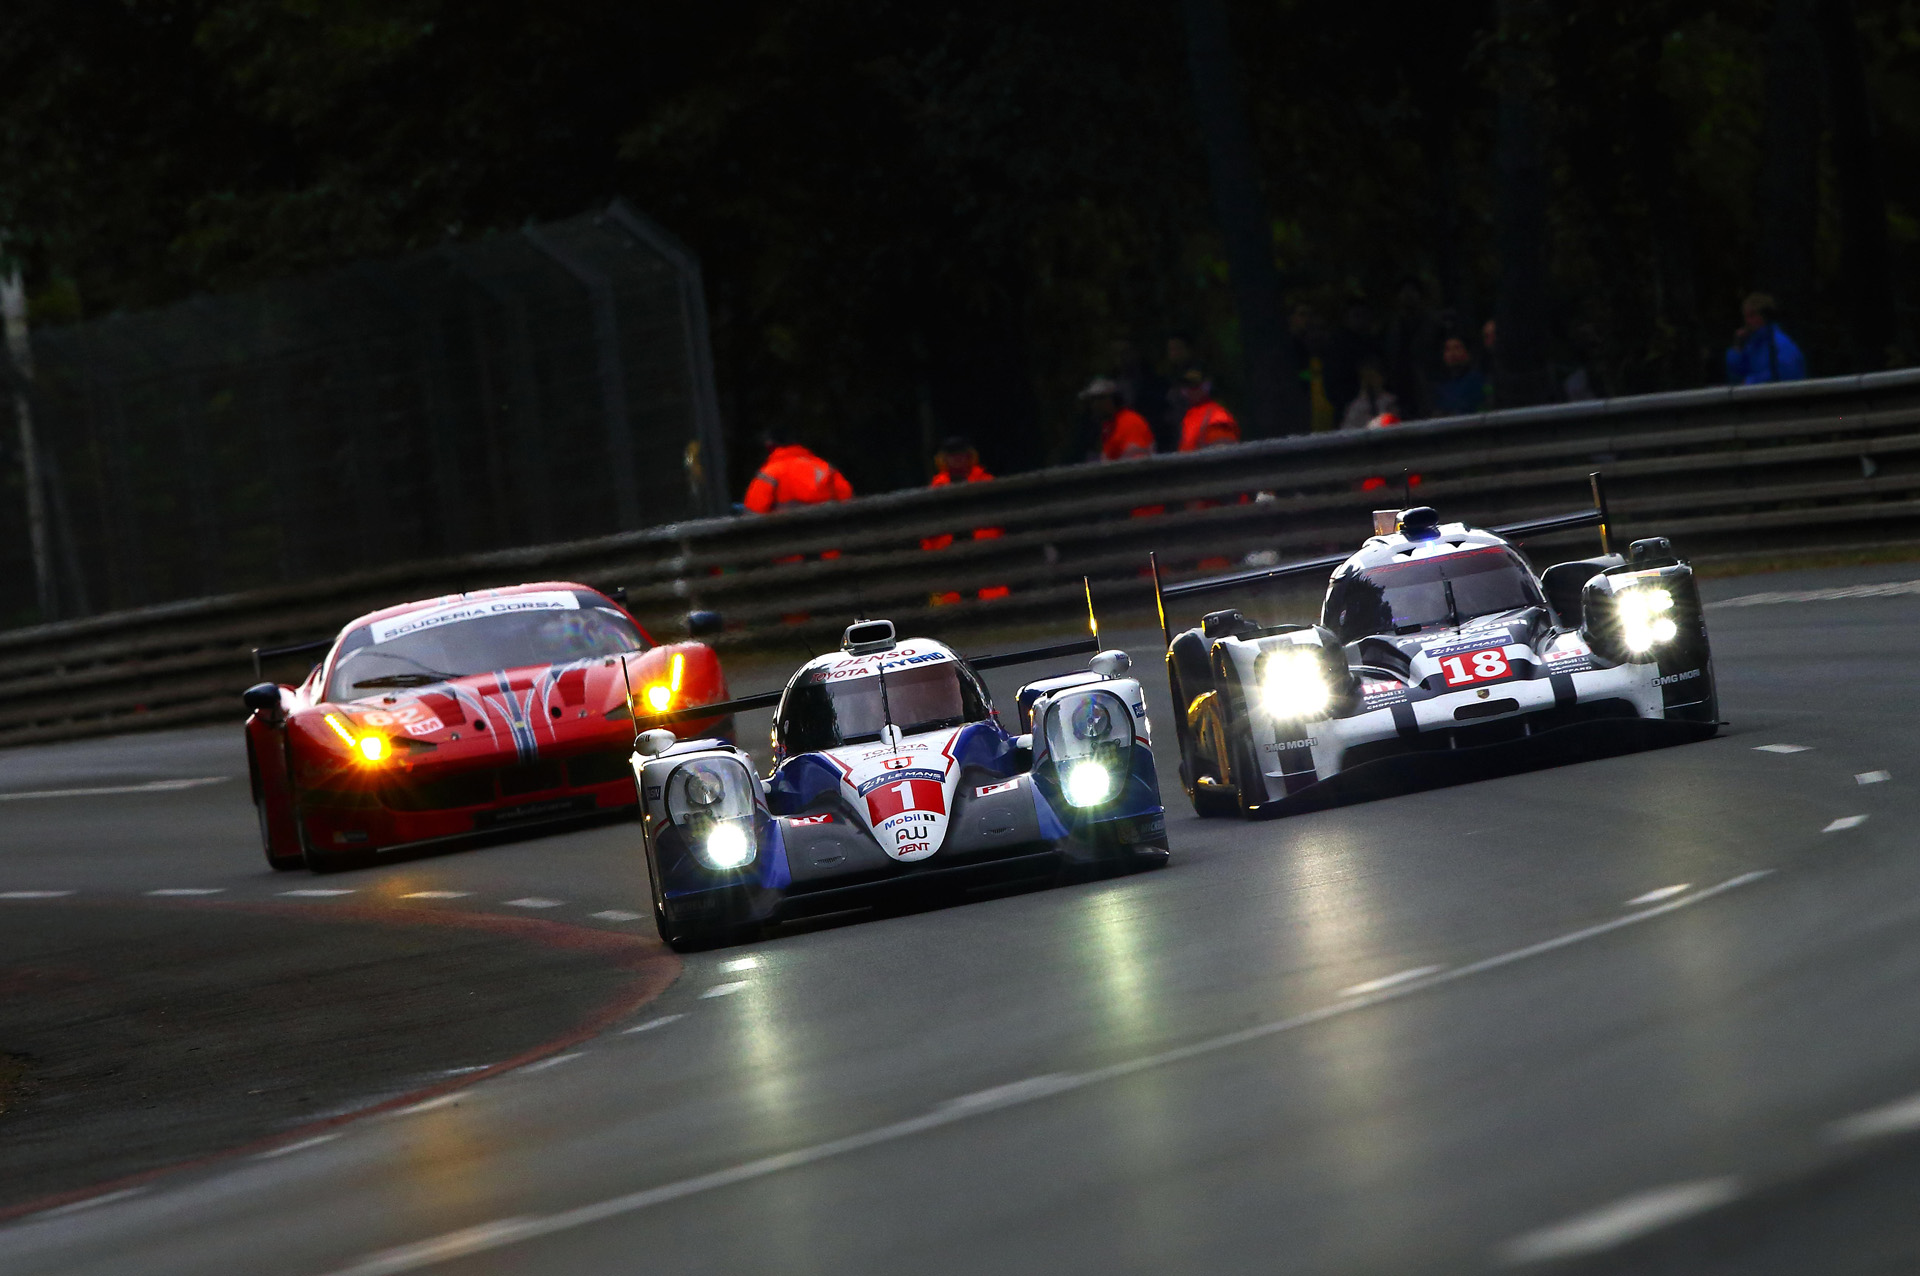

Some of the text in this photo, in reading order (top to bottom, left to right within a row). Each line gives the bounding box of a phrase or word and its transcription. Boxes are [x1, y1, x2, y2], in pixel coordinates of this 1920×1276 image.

[383, 601, 565, 638] SCUDERIA CORSA
[835, 649, 916, 668] DENSO
[1547, 658, 1578, 667] Mobil
[810, 652, 946, 683] TOYOTA HYBRID
[1442, 651, 1507, 684] 18
[1551, 666, 1592, 675] CHOPARD
[1652, 668, 1700, 687] DMG MORI
[1363, 681, 1398, 694] HY
[1363, 692, 1393, 701] Mobil
[1366, 699, 1408, 710] CHOPARD
[363, 708, 425, 726] 62
[411, 720, 439, 733] AM
[862, 744, 928, 762] TOYOTA
[1264, 737, 1318, 753] DMG MORI
[888, 772, 903, 780] LE
[905, 770, 942, 779] MANS
[891, 781, 915, 810] 1
[792, 814, 828, 825] HY
[884, 814, 921, 830] Mobil
[898, 842, 930, 856] ZENT
